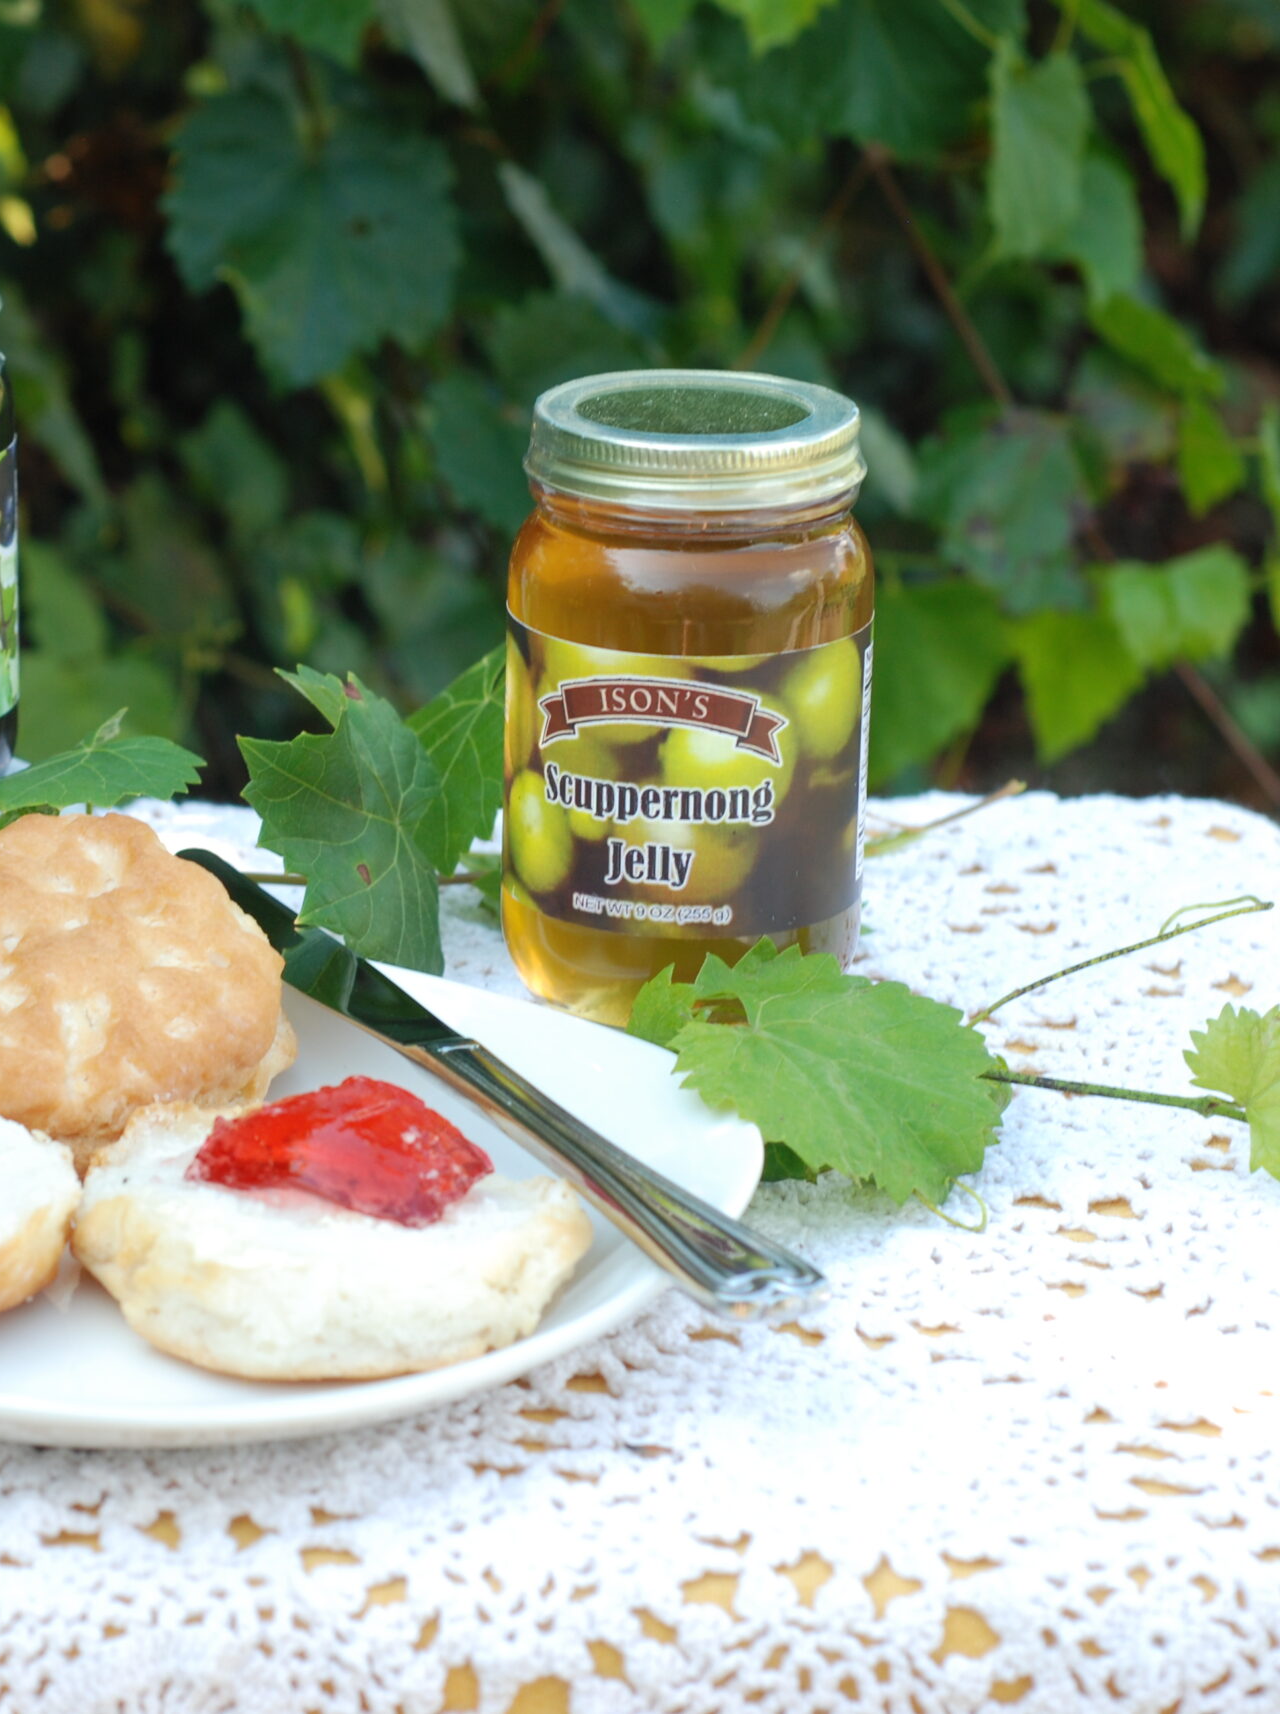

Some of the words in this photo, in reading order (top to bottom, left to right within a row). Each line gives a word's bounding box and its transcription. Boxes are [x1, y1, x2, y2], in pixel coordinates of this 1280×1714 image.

[599, 687, 710, 719] ISON'S
[545, 763, 774, 823] Scuppernong
[605, 840, 693, 888] Jelly
[573, 893, 603, 914] NET
[606, 899, 631, 919] WT
[635, 904, 646, 919] 9
[649, 904, 673, 922] OZ
[676, 905, 712, 925] (255
[713, 904, 732, 925] g)
